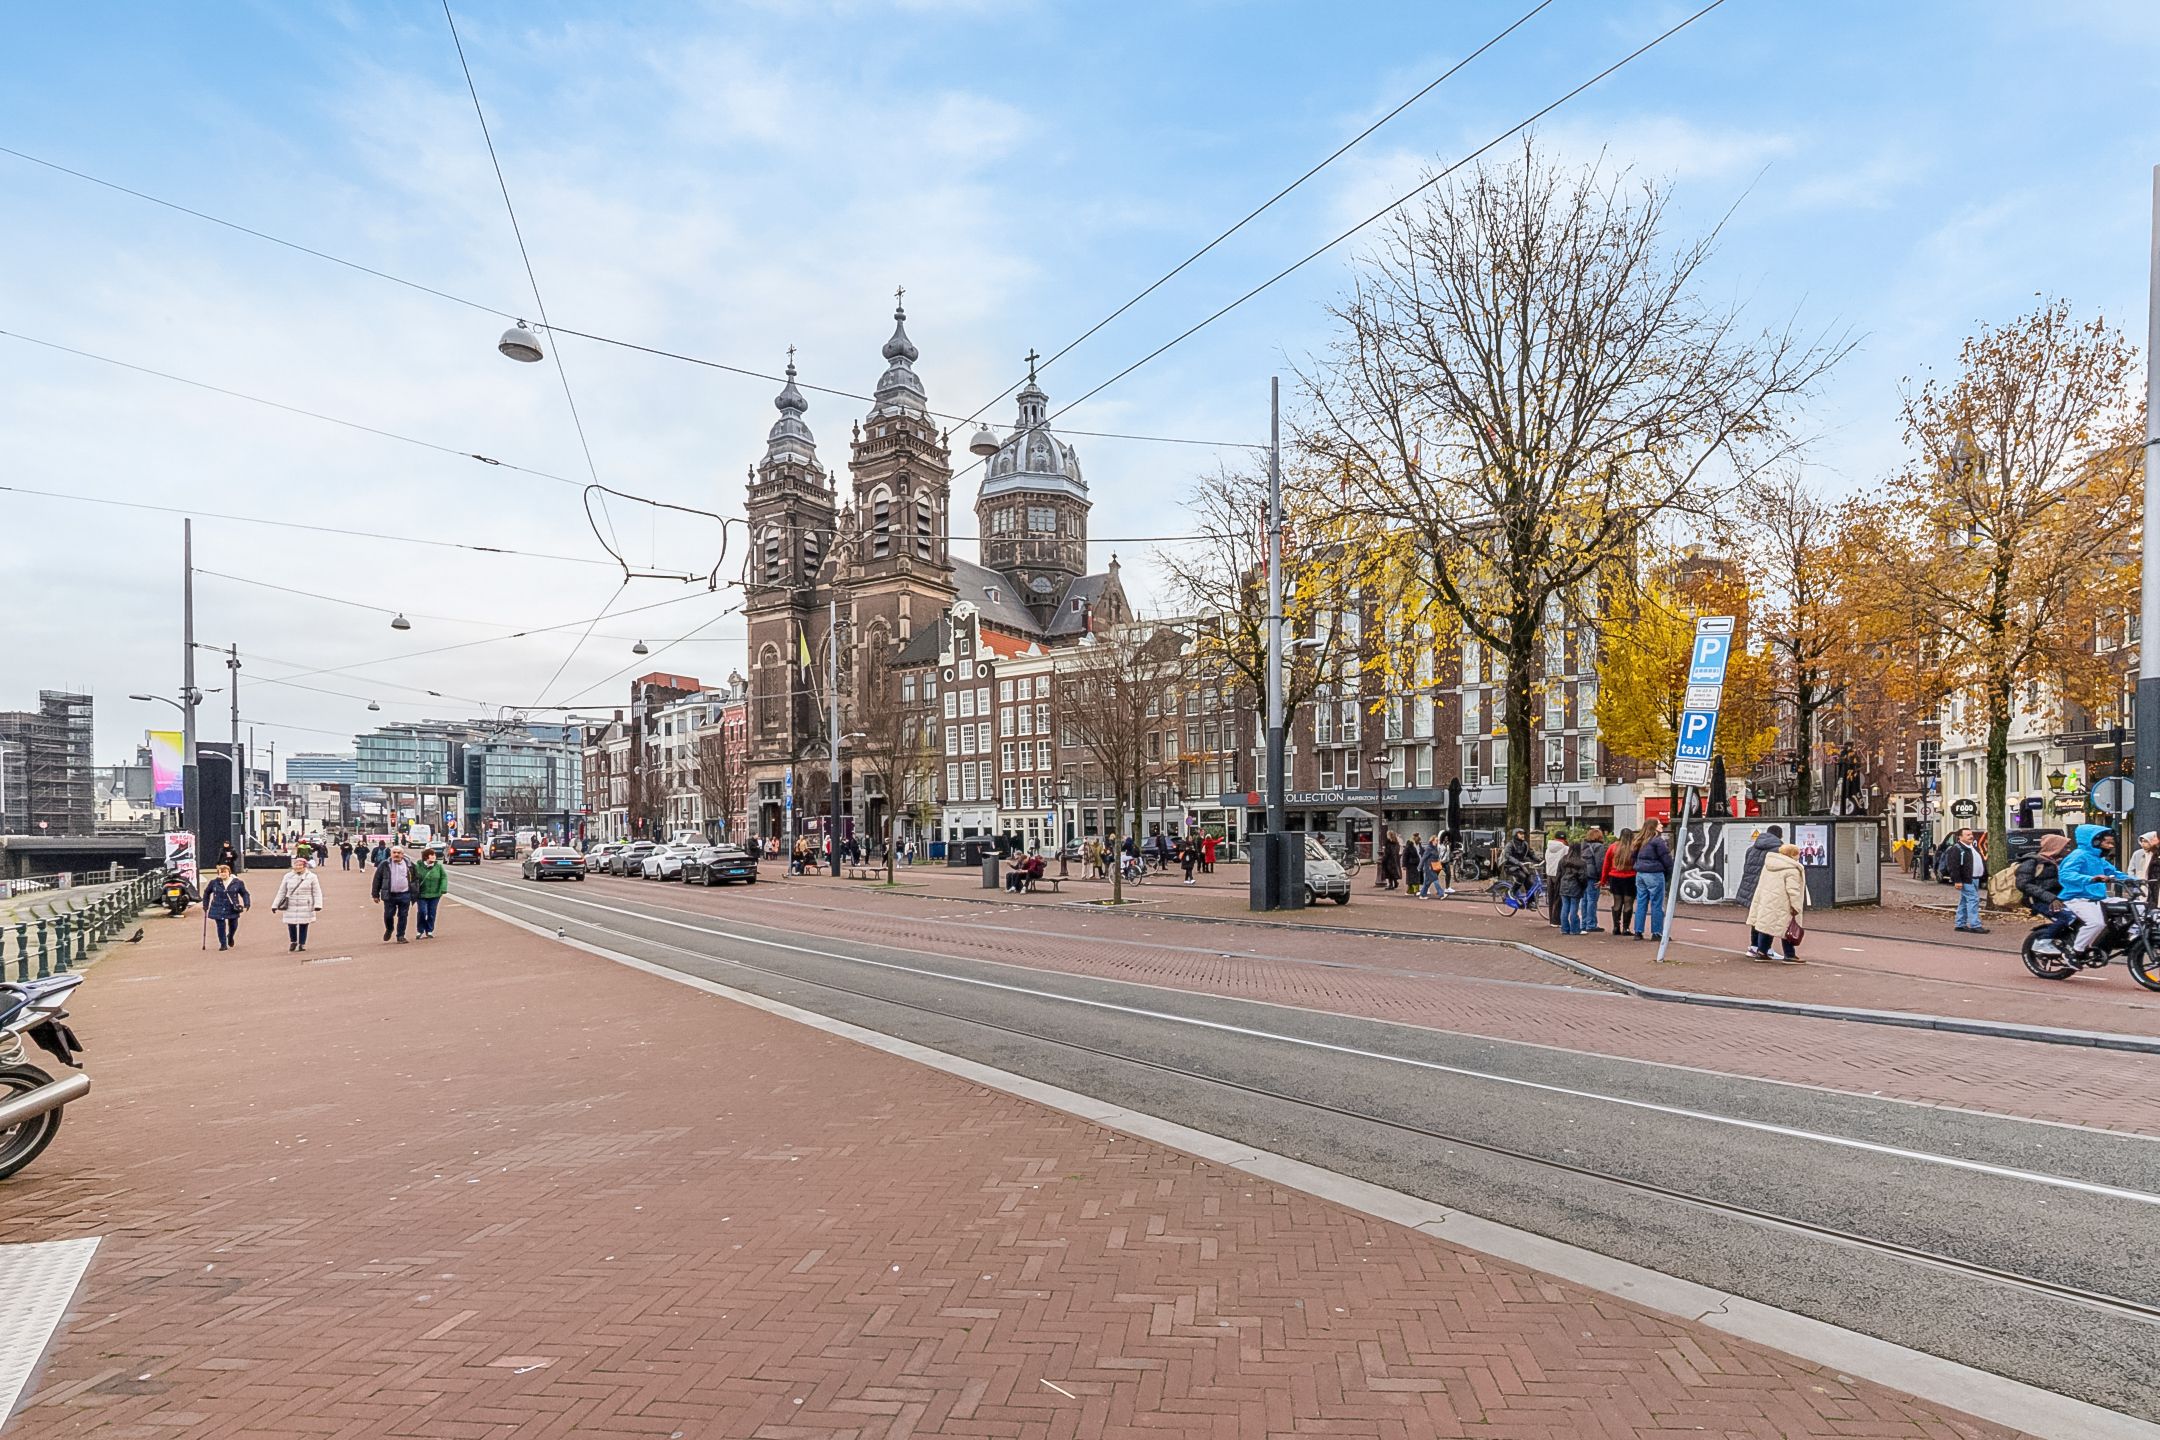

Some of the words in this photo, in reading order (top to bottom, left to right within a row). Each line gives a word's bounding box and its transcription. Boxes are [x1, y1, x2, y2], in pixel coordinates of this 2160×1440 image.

[1699, 638, 1721, 664] P
[1686, 714, 1708, 739] P
[1681, 743, 1707, 755] taxi
[1284, 792, 1344, 802] OLLECTION
[1955, 804, 1974, 812] FOOD
